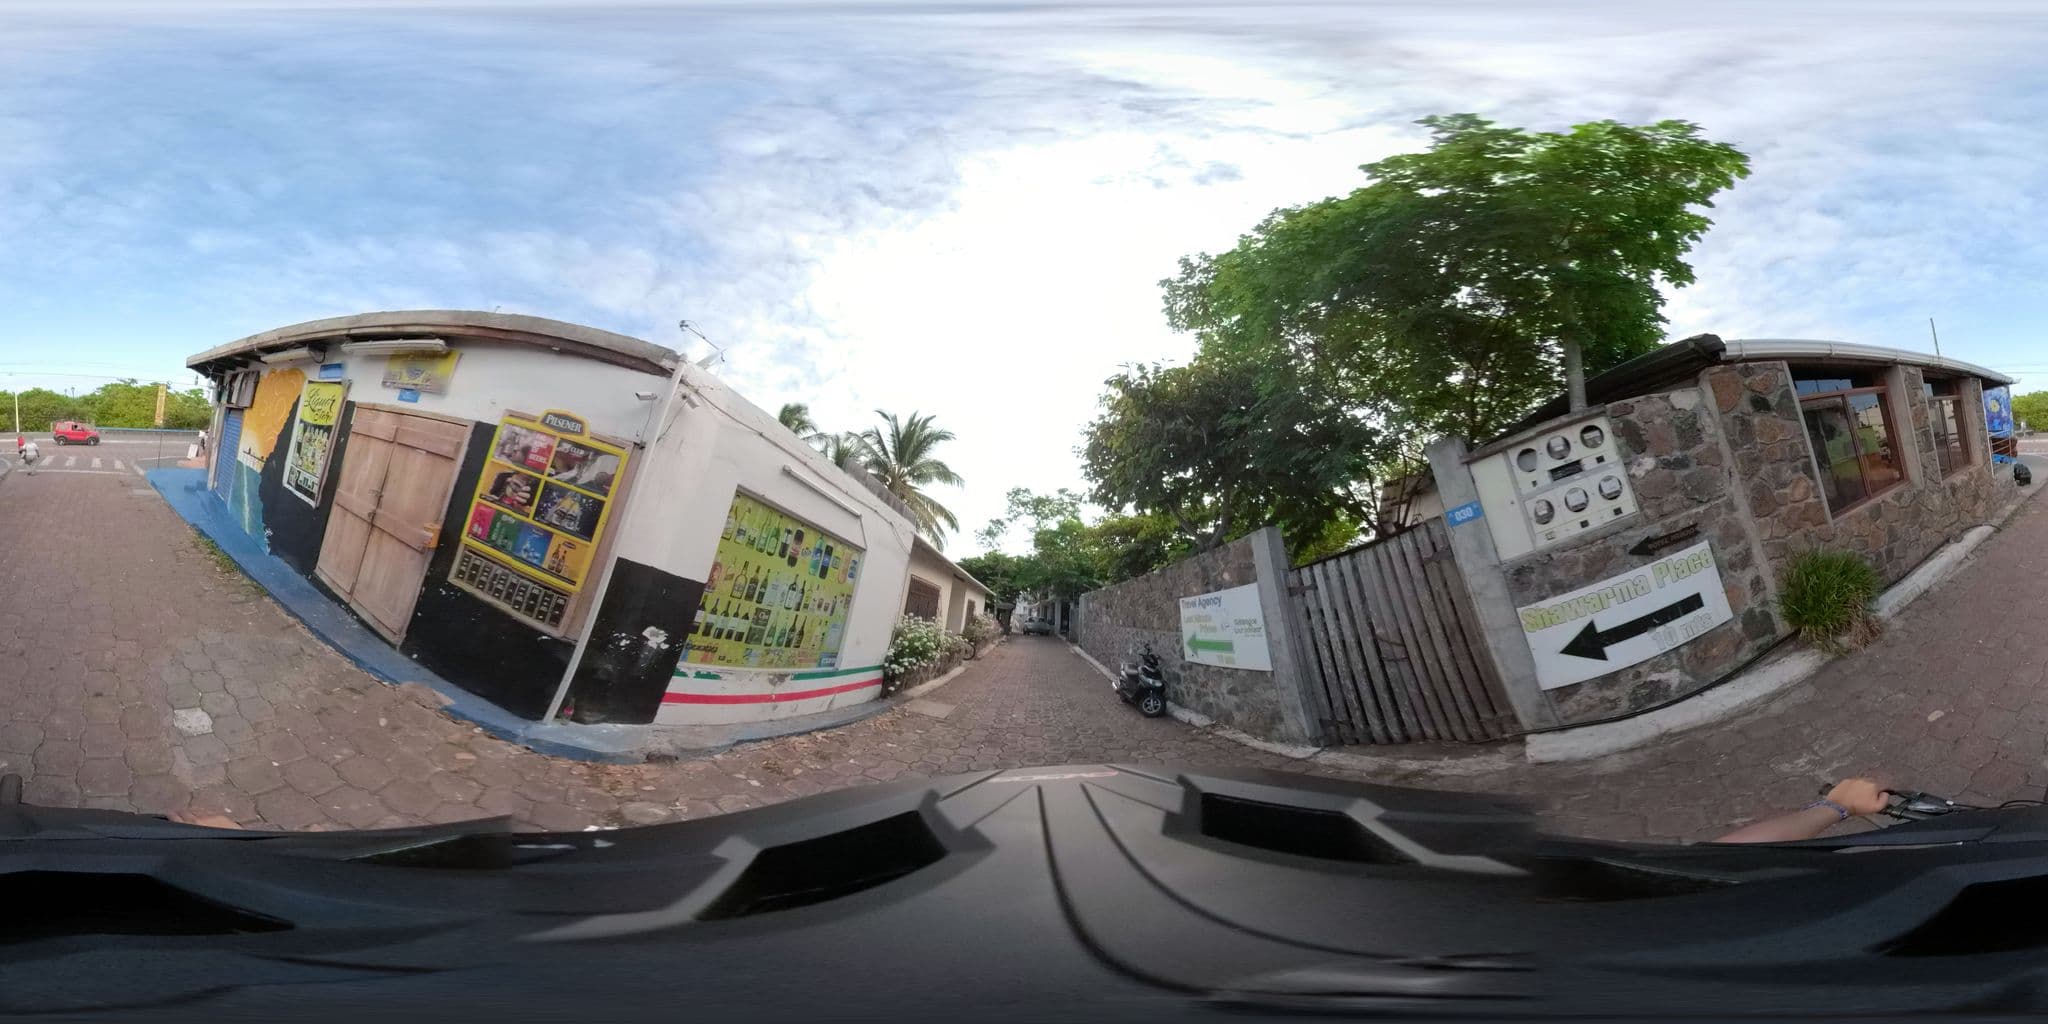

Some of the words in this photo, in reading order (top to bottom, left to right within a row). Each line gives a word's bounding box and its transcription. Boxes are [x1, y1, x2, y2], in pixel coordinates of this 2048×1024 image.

[545, 414, 582, 433] PILSENER
[1197, 595, 1222, 610] Agency
[1520, 574, 1651, 633] Shawarma
[1651, 549, 1715, 589] Place
[1652, 624, 1678, 651] 10
